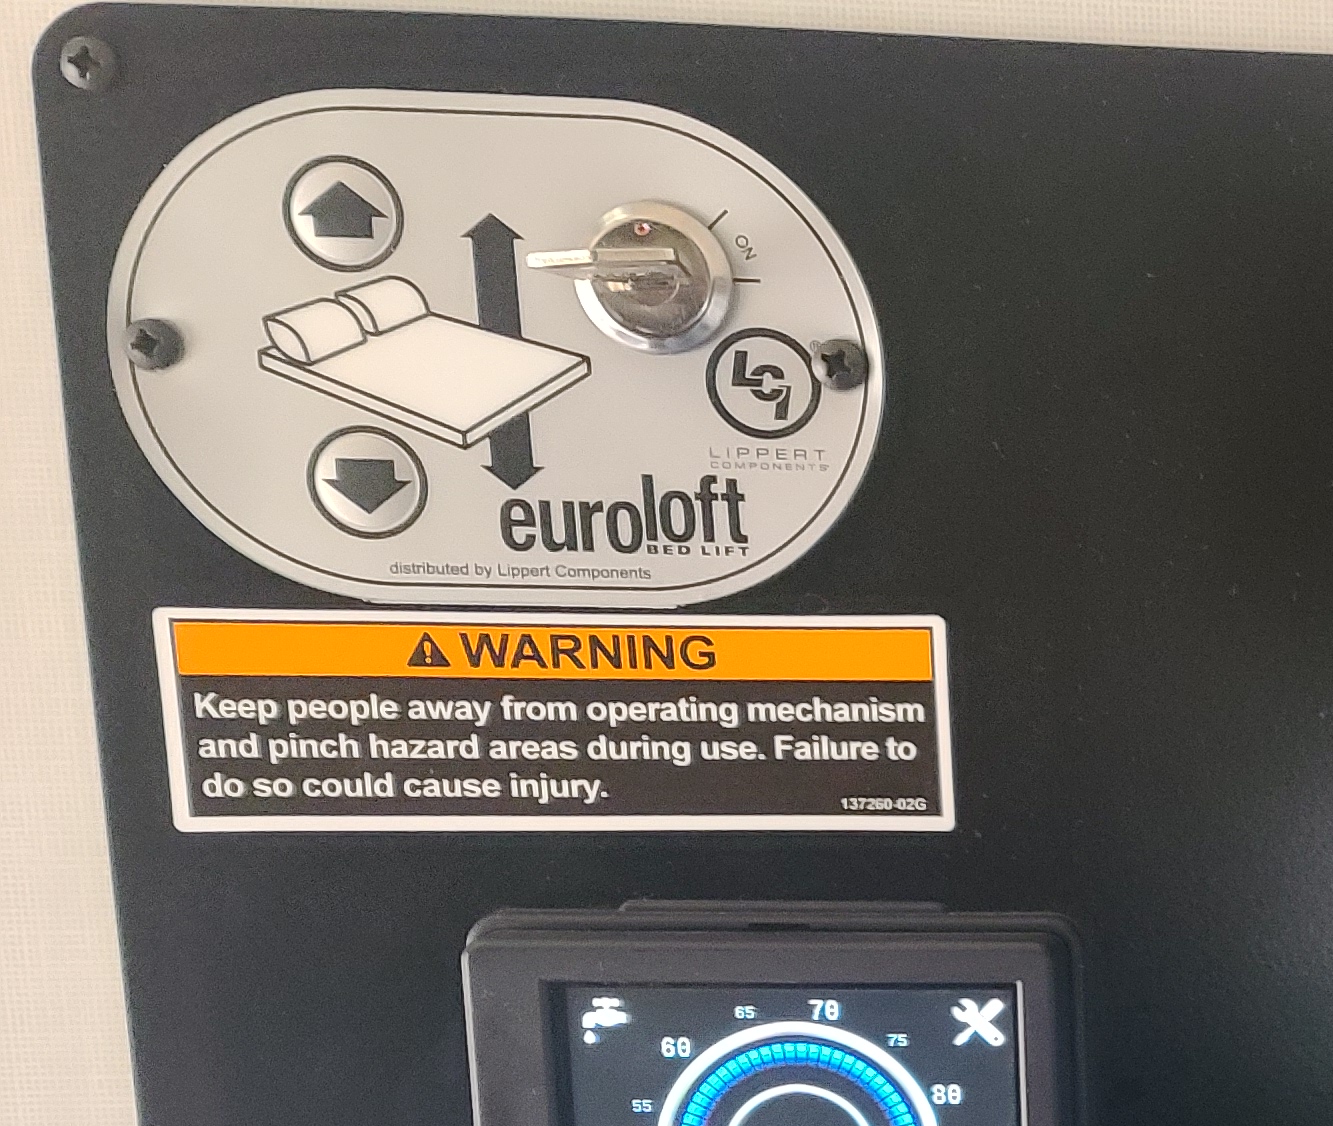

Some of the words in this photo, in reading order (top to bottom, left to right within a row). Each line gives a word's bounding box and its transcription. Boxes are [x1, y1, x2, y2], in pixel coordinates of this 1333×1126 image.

[735, 235, 757, 260] ON
[709, 447, 826, 461] LIPPERT
[500, 474, 748, 553] euroloft
[646, 544, 691, 555] BED
[700, 546, 750, 557] LIFT
[390, 562, 469, 576] distributed
[474, 563, 493, 579] by
[498, 565, 551, 580] Lippert
[555, 565, 651, 580] Components
[460, 631, 717, 670] WARNING
[194, 692, 279, 725] Keep
[288, 692, 399, 727] people
[407, 698, 493, 728] away
[500, 695, 578, 722] from
[586, 697, 739, 729] operating
[746, 697, 926, 724] mechanism
[198, 733, 258, 760] and
[268, 733, 360, 766] pinch
[368, 734, 479, 761] hazard
[488, 737, 580, 762] areas
[586, 736, 693, 768] during
[700, 740, 767, 762] use.
[774, 737, 881, 763] Failure
[885, 738, 918, 763] to
[202, 772, 245, 799] do
[252, 777, 294, 799] so
[302, 772, 395, 800] could
[403, 777, 501, 801] cause
[509, 772, 609, 806] injury.
[734, 1005, 756, 1020] 65
[808, 999, 841, 1022] 70
[661, 1037, 691, 1057] 60
[887, 1034, 910, 1047] 75
[931, 1084, 962, 1105] 80
[632, 1099, 653, 1113] 55
